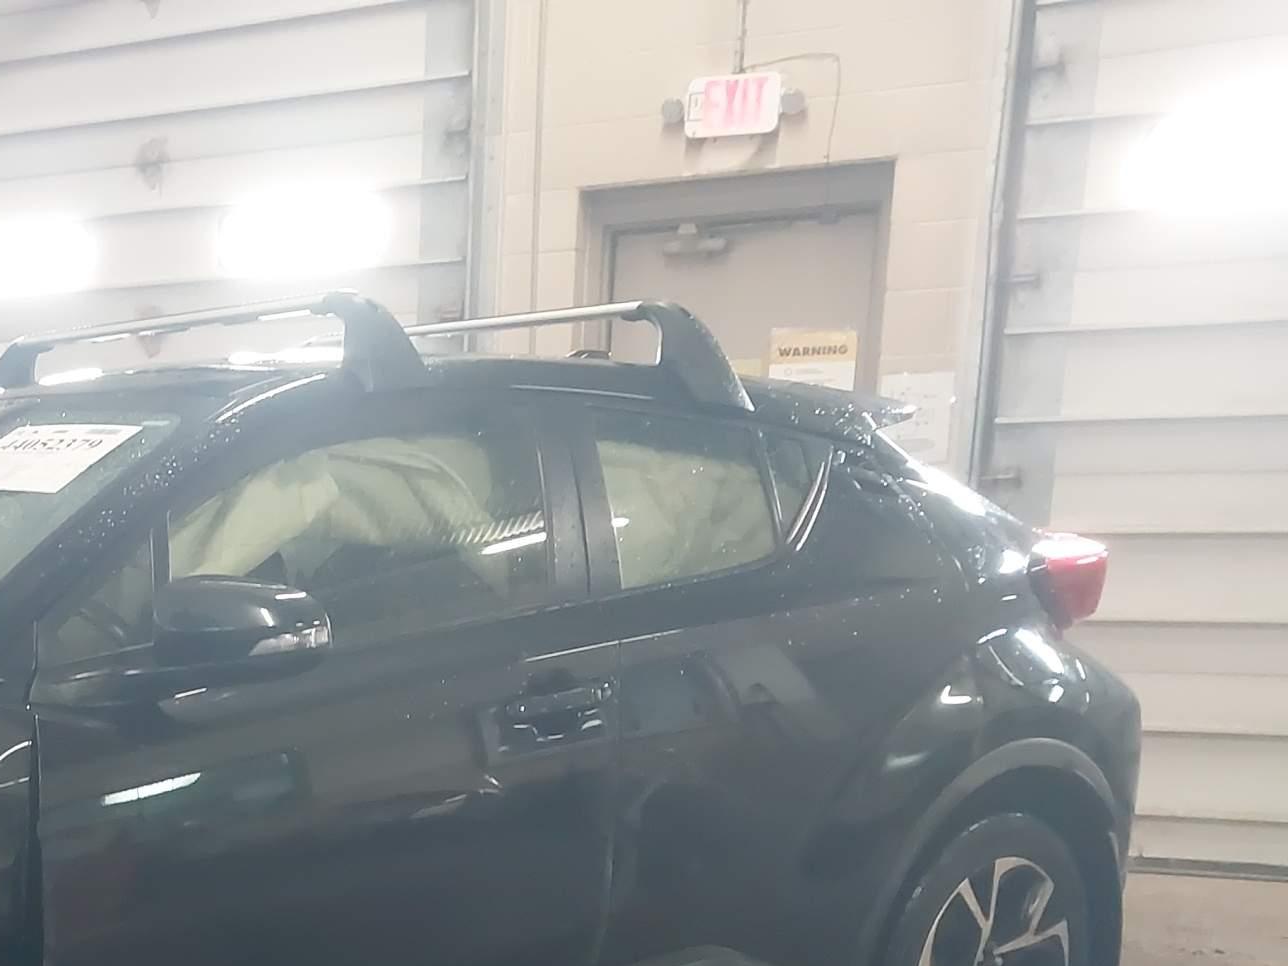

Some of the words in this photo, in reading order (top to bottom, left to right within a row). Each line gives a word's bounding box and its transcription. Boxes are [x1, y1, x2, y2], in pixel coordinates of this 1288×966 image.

[704, 77, 768, 129] EXIT
[778, 344, 849, 358] WARNING
[0, 439, 104, 450] 44052379
